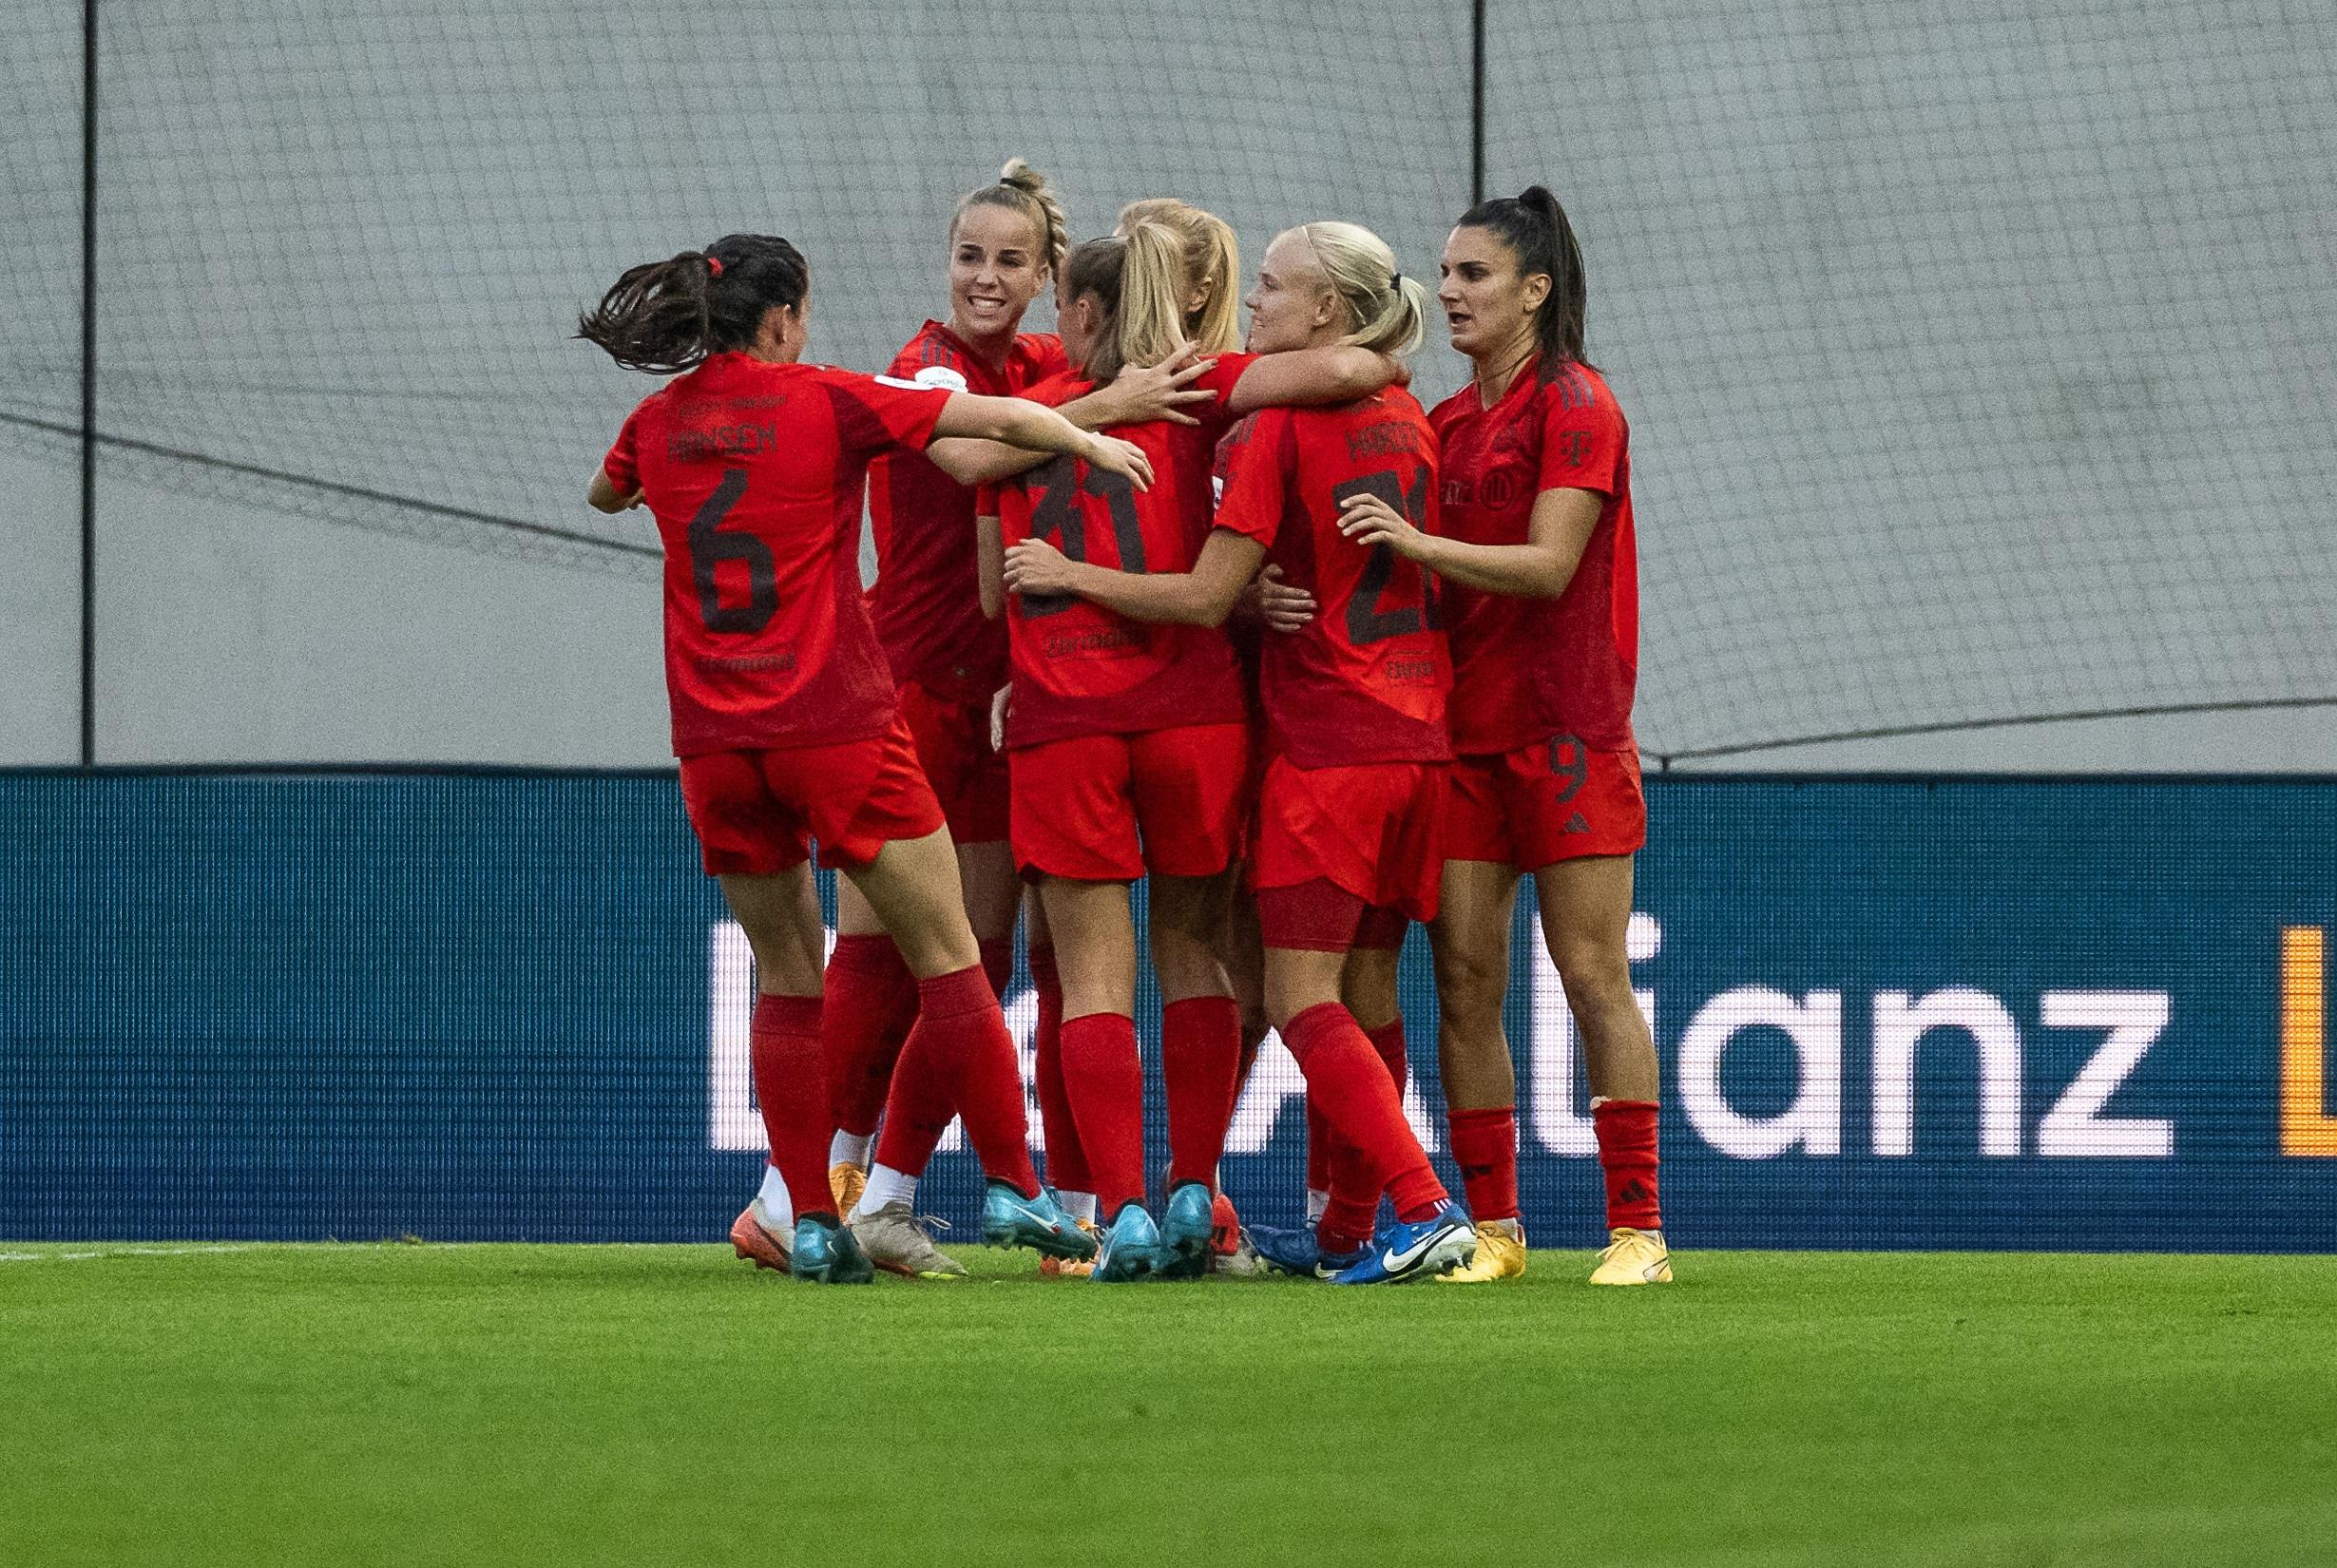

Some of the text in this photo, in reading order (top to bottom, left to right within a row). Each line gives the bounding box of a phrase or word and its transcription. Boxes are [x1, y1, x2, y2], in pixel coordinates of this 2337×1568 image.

[687, 468, 779, 634] 6
[1551, 734, 1587, 803] 9
[1222, 911, 2174, 1158] lianz
